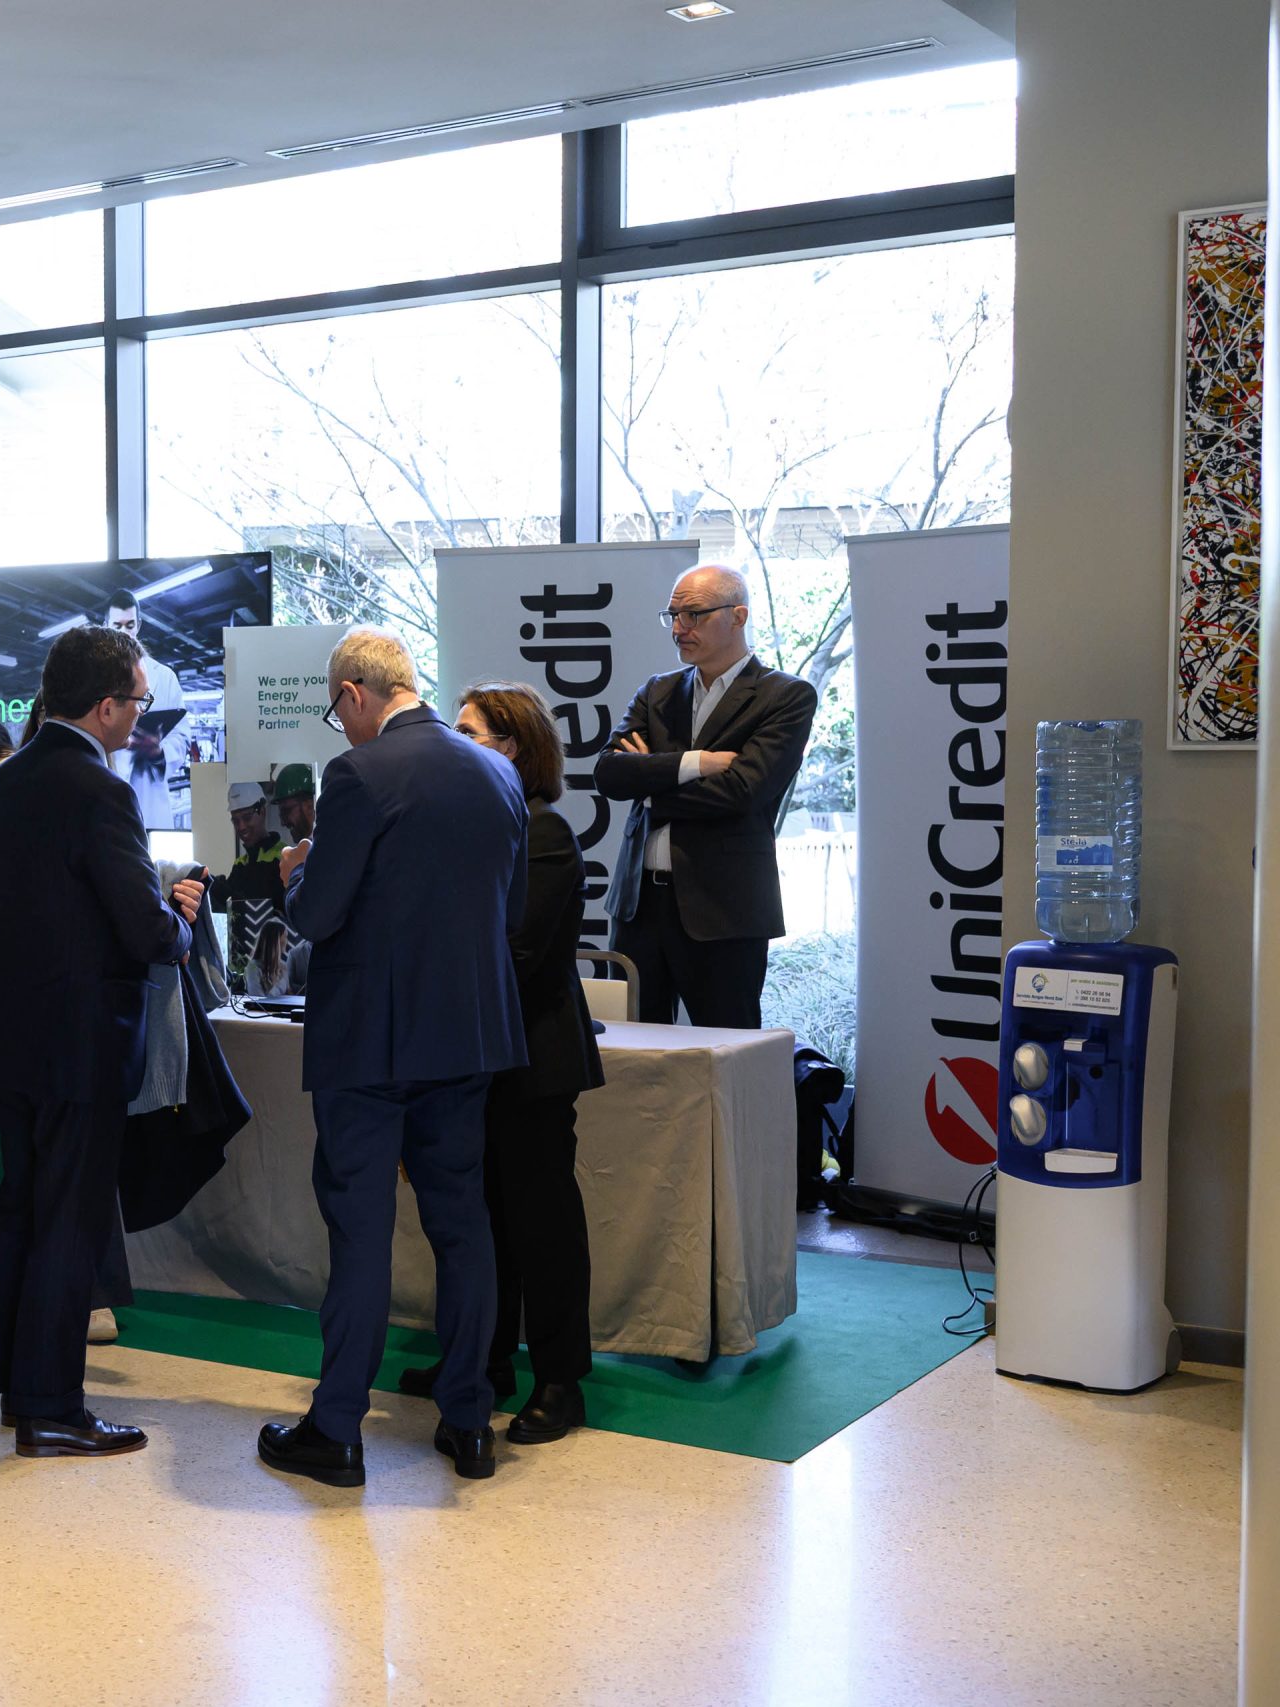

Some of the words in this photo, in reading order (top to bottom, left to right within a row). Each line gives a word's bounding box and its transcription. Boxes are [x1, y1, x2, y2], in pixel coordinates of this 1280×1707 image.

[257, 676, 276, 686] We
[280, 677, 299, 686] are
[258, 690, 298, 702] Energy
[258, 703, 328, 715] Technology
[258, 719, 300, 730] Partner
[924, 600, 1008, 1042] UniCredit
